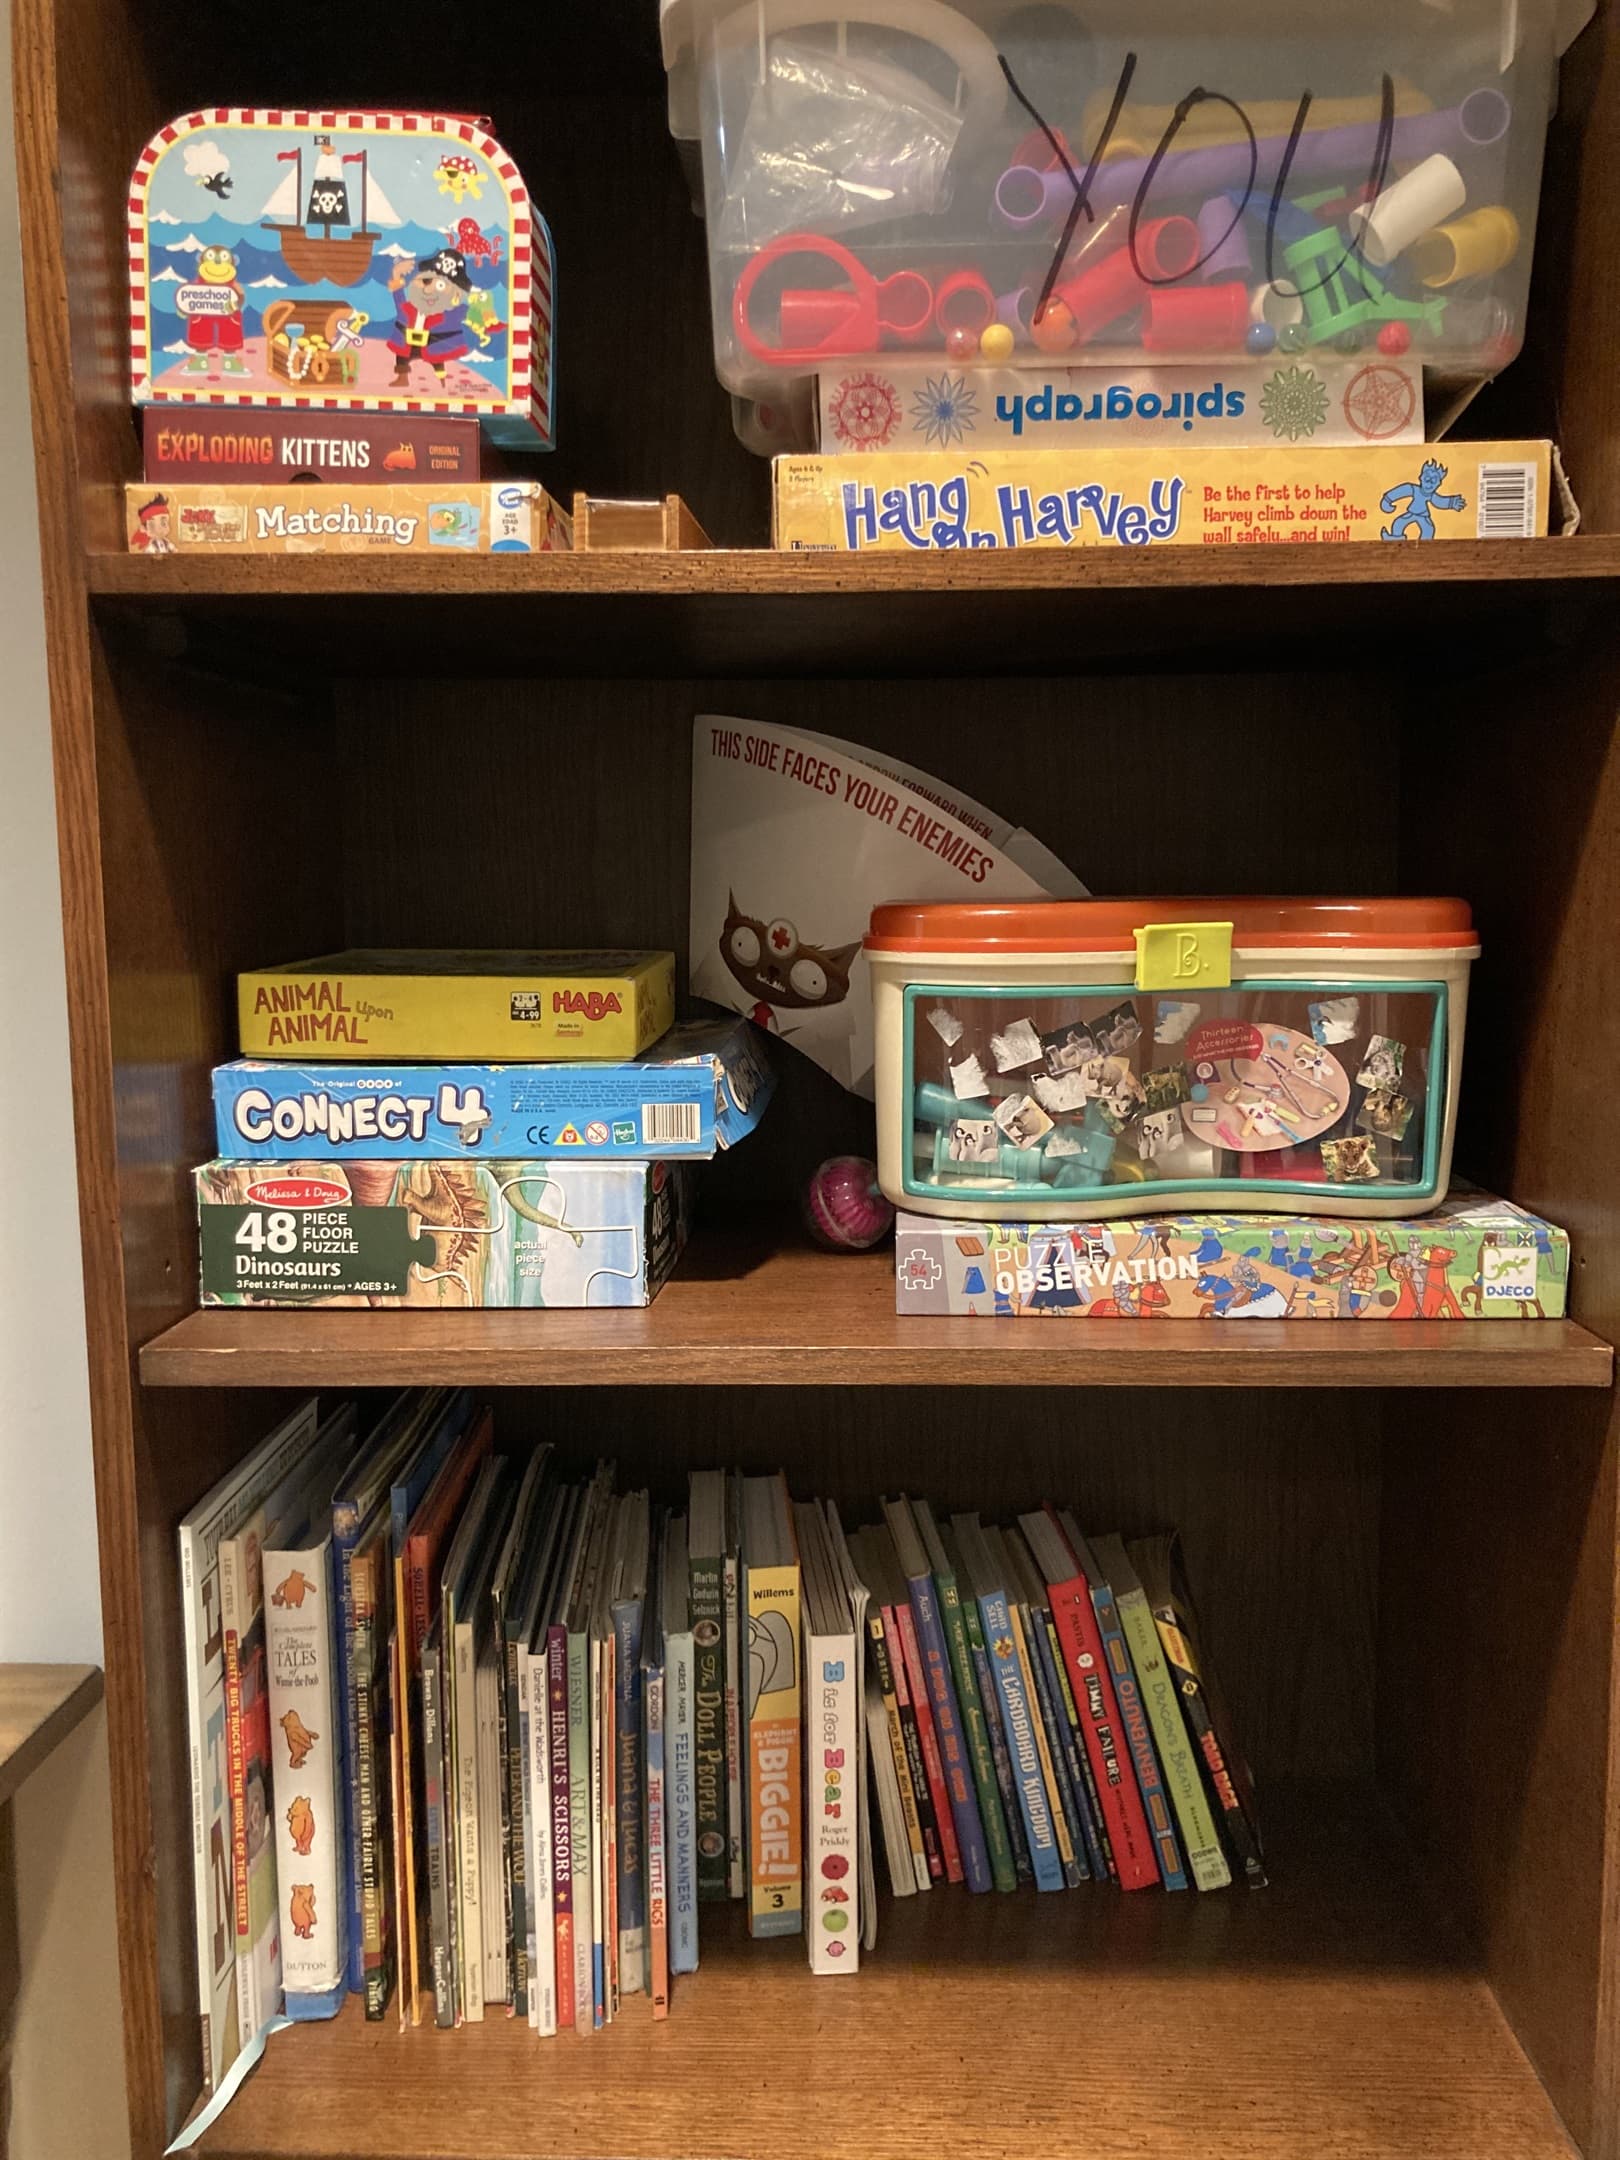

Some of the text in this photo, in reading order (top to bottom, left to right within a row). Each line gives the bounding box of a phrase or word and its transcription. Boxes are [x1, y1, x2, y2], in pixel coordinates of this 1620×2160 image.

[181, 288, 231, 302] preschool
[189, 300, 224, 311] games
[996, 382, 1247, 435] spirograph
[157, 429, 371, 468] EXPLODING KITTENS
[429, 445, 461, 456] ORIGINAL
[431, 459, 459, 470] EDITION
[1203, 483, 1346, 501] Be the first to help
[255, 503, 418, 546] Matching
[842, 477, 968, 550] Hang
[997, 477, 1186, 548] Harvey
[1203, 504, 1367, 526] Harvey climb down the
[368, 537, 392, 545] GAME
[503, 525, 517, 535] 3+
[1203, 527, 1232, 544] wall
[1322, 526, 1350, 542] win!
[711, 729, 742, 760] THIS
[744, 735, 780, 773] SIDE
[782, 748, 841, 795] FACES
[843, 774, 899, 826] YOUR
[897, 806, 995, 884] ENEMIES
[254, 981, 351, 1015] ANIMAL
[552, 990, 622, 1021] HABA
[268, 1013, 369, 1046] ANIMAL
[520, 1010, 539, 1020] 4-99
[1195, 1034, 1255, 1053] Accessories
[1201, 1026, 1245, 1041] Thirteen
[327, 1080, 355, 1088] Original
[235, 1087, 434, 1145] CONNECT
[438, 1083, 490, 1146] 4
[255, 1184, 341, 1204] Melissa Doug
[235, 1212, 298, 1254] 48
[303, 1213, 348, 1225] PIECE
[303, 1227, 353, 1239] FLOOR
[303, 1242, 360, 1254] PUZZLE
[514, 1240, 548, 1250] actual
[516, 1252, 546, 1265] piece
[994, 1239, 1107, 1271] PUZZLE
[235, 1254, 341, 1276] Dinosaurs
[519, 1266, 542, 1277] size
[910, 1264, 927, 1277] 54
[995, 1254, 1200, 1294] OBSERVATION
[236, 1280, 243, 1289] 3
[244, 1280, 263, 1289] Feet
[272, 1280, 278, 1290] 2
[279, 1281, 299, 1290] Feet
[333, 1283, 346, 1291] cm)
[354, 1281, 381, 1291] AGES
[384, 1282, 397, 1291] 3+
[1486, 1286, 1535, 1297] DJECO
[224, 1557, 232, 1575] LEE
[693, 1572, 718, 1584] Martin
[340, 1548, 354, 1627] In Light of
[753, 1588, 795, 1599] Willems
[692, 1604, 720, 1615] Selznick
[919, 1595, 932, 1622] Auch
[986, 1604, 998, 1631] SELL
[274, 1650, 317, 1667] TALES
[622, 1621, 632, 1701] JUANA MEDINA
[1001, 1664, 1016, 1676] THE
[677, 1661, 686, 1692] MERCER
[424, 1669, 435, 1744] Brown Dillons
[677, 1697, 686, 1724] MAYER
[533, 1667, 546, 1784] Danielle at the Wadsworth
[696, 1654, 723, 1822] The DOLL PEOPLE
[752, 1728, 797, 1739] ELEPHANT
[1001, 1676, 1036, 1773] CARDBOARD
[1084, 1673, 1107, 1720] TIMMY
[1097, 1725, 1122, 1786] FAILURE
[1119, 1679, 1158, 1788] BENVENUTO
[766, 1736, 795, 1746] PIGGIE
[823, 1661, 845, 1819] B is for Bear
[550, 1638, 570, 1881] winter HENRI'S SCISSORS
[570, 1655, 587, 1876] WIESNER ART & MAX
[676, 1732, 690, 1805] FEELINGS
[889, 1710, 916, 1828] March of the Mini Beasts
[227, 1639, 248, 1926] TWENTY BIG TRUCKS IN THE MIDDLE OF THE STREET
[1170, 1751, 1192, 1799] BREATH
[357, 1672, 377, 1940] THE STINKY CHEESE MAN AND OTHER FAIRLY STUPID TALES
[510, 1747, 526, 1886] PETER AND THE WOLF
[619, 1729, 638, 1874] Juana Lucas
[649, 1685, 663, 1926] GORDON THE THREE LITTLE RIGS
[758, 1748, 798, 1876] BIGGIE!
[1022, 1776, 1053, 1849] KINGDOM
[461, 1757, 477, 1905] The Pigeon Wants Puppy!
[677, 1808, 689, 1839] AND
[822, 1825, 848, 1835] Roger
[820, 1837, 850, 1847] Priddy
[430, 1847, 440, 1890] TRAINS
[677, 1842, 690, 1913] MANNERS
[763, 1884, 791, 1893] Volume
[772, 1894, 784, 1908] 3
[286, 1960, 327, 1971] DUTTON
[434, 1946, 445, 2013] HarperCollins
[367, 1982, 379, 2012] VIKING
